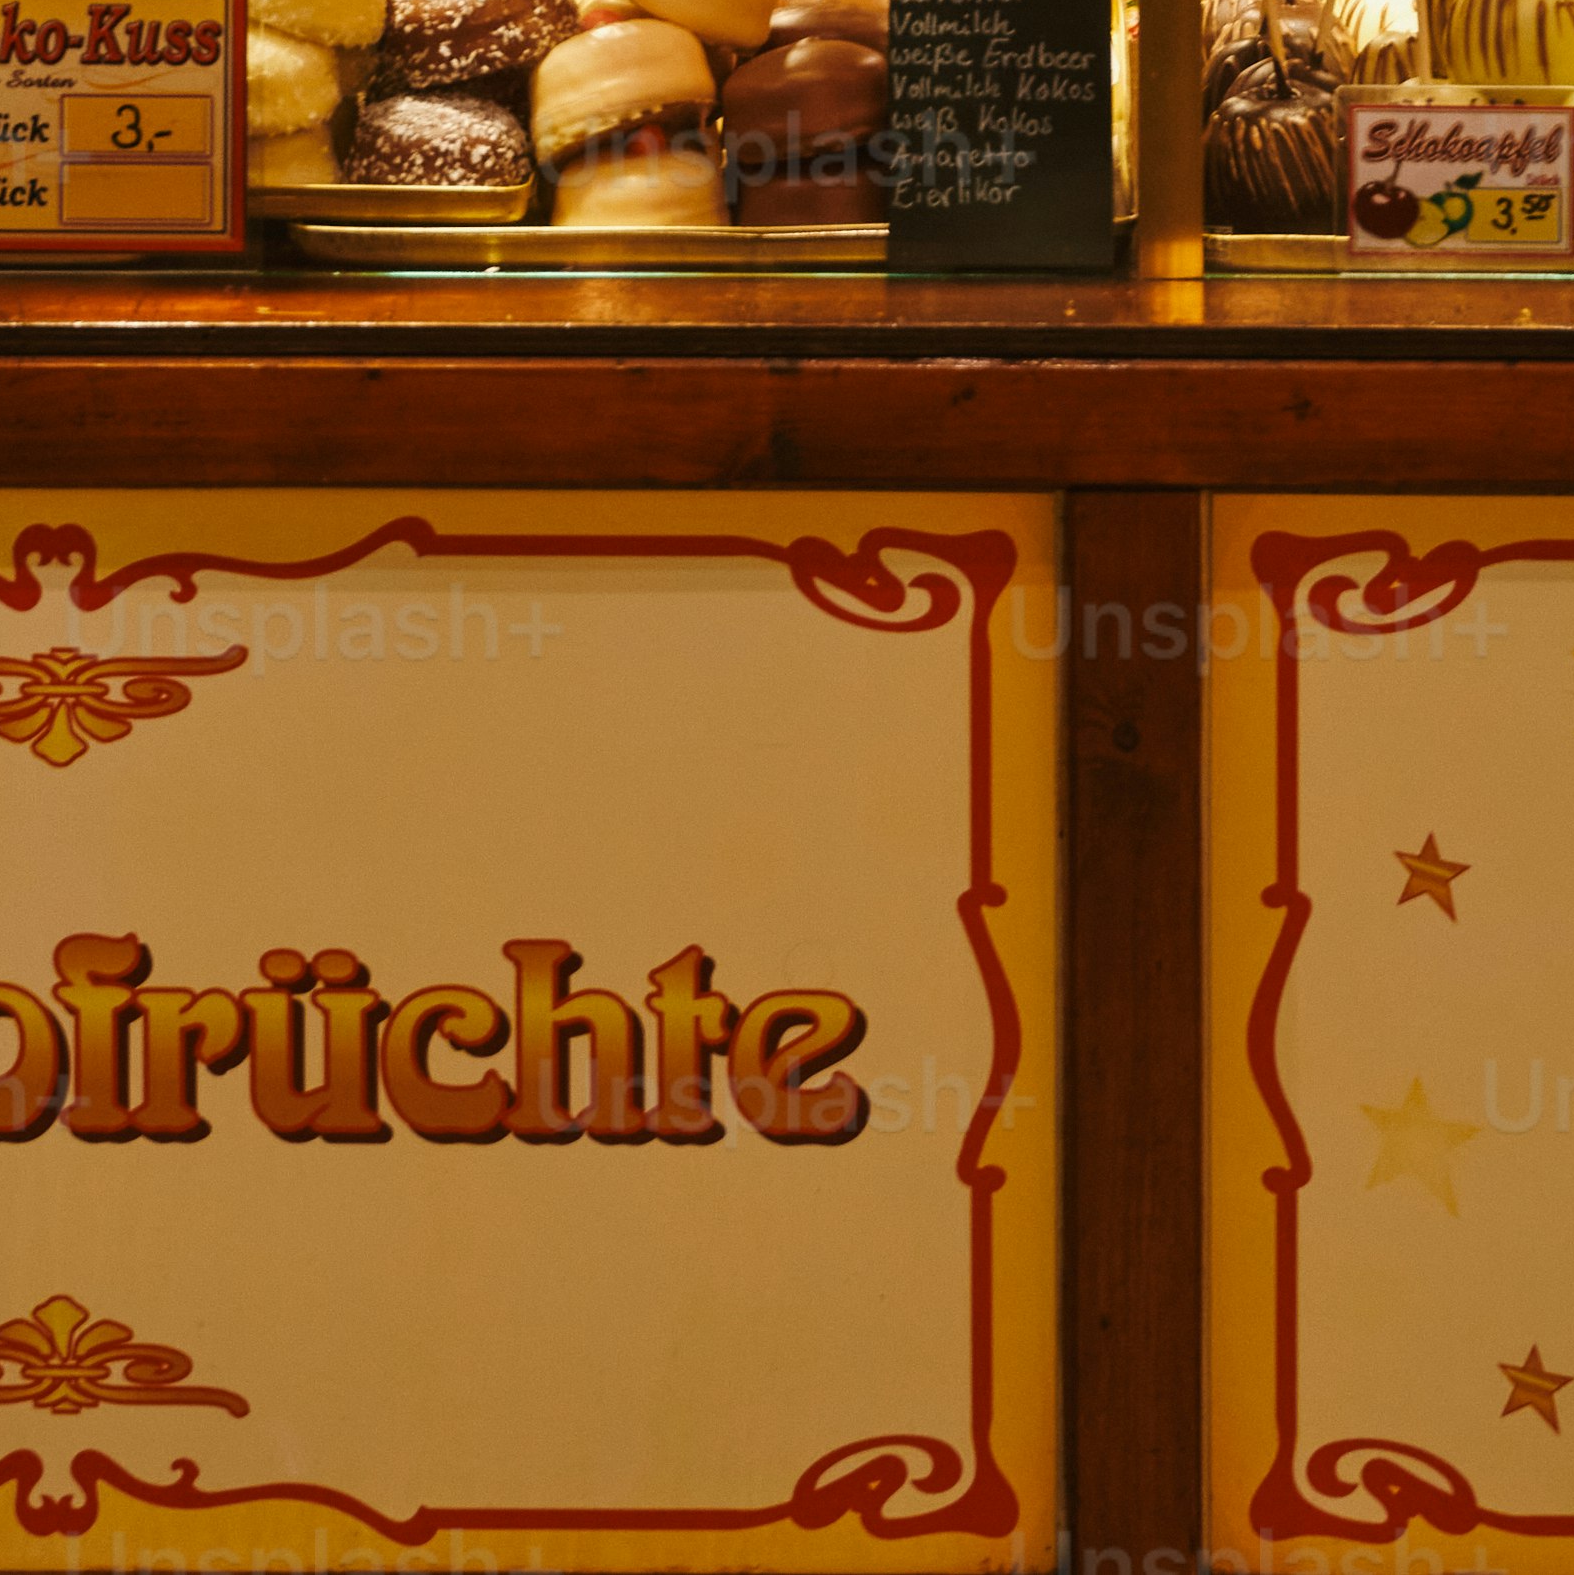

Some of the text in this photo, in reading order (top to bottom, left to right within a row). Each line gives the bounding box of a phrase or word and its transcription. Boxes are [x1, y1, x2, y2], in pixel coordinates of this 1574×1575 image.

[891, 10, 1017, 37] Vollmilch
[983, 37, 1097, 69] Erdbeer
[5, 69, 78, 88] Sorten
[891, 72, 1097, 101] Vollmilch Kokos
[976, 103, 1054, 137] Kokos
[889, 139, 1030, 170] Amaretto
[1362, 118, 1565, 177] Schokoapfel
